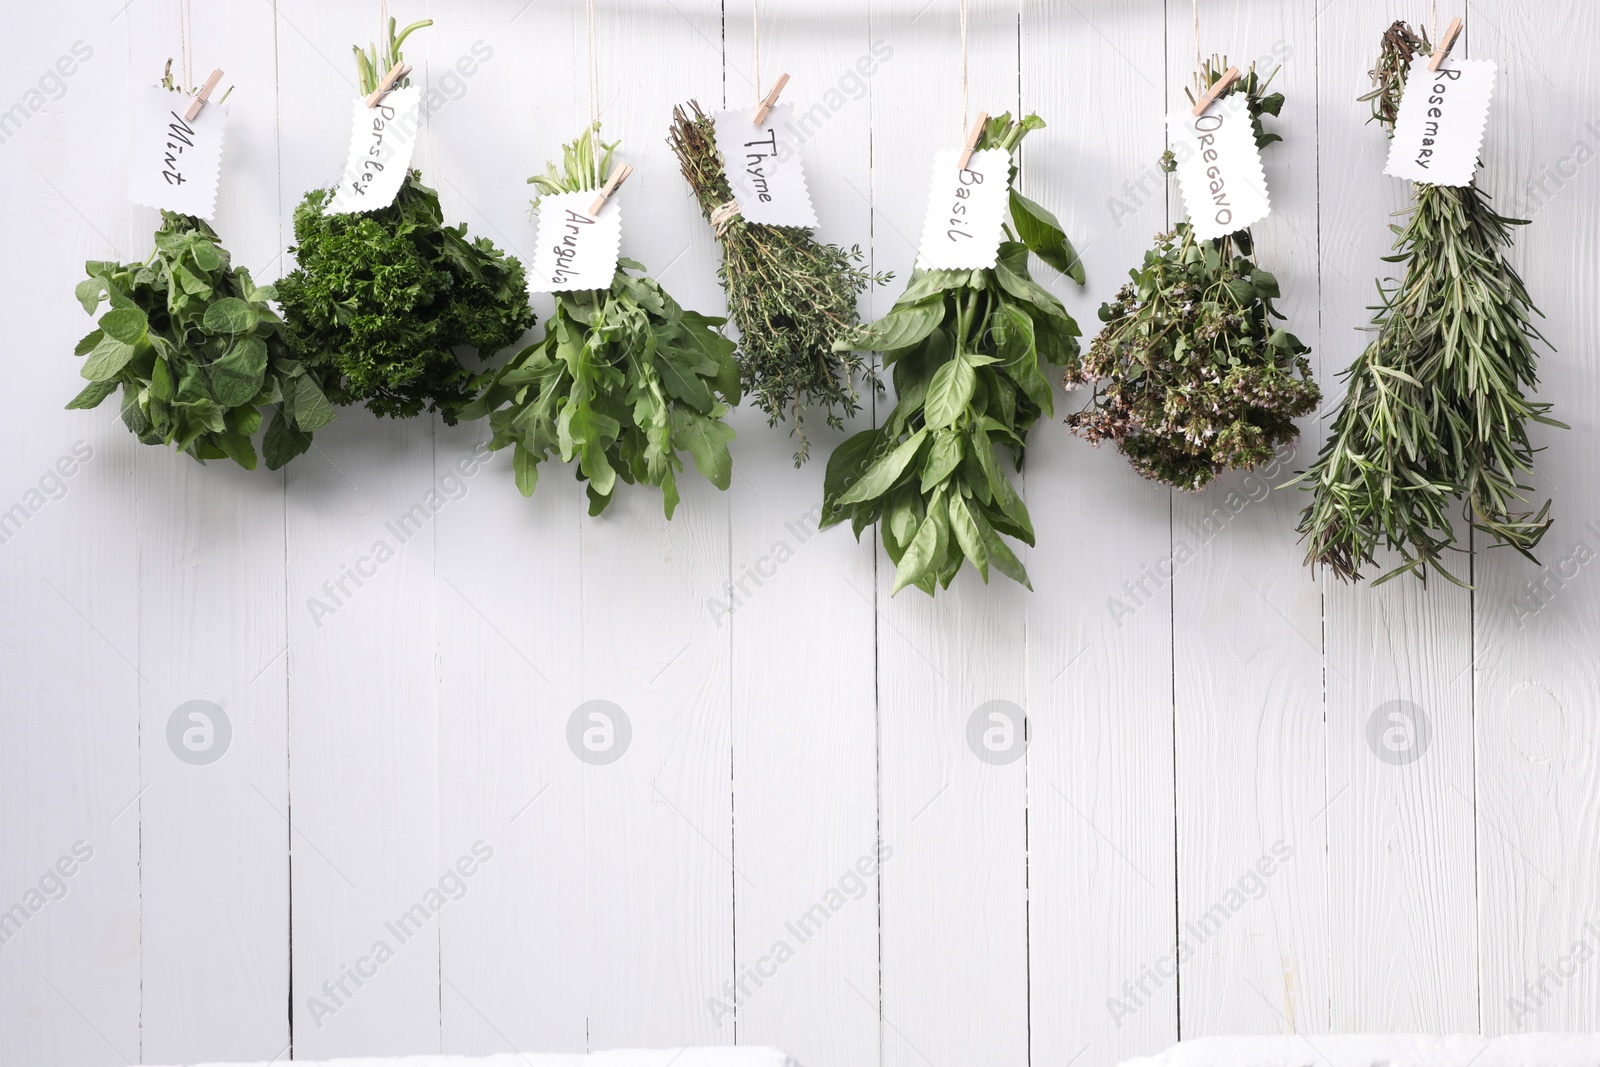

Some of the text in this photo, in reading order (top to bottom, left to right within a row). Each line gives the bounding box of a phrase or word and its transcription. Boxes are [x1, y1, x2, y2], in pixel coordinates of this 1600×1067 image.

[162, 111, 195, 185] Mint
[352, 104, 395, 198] Parsley
[744, 128, 777, 203] Thyme
[947, 168, 984, 243] Basil
[552, 209, 595, 284] Arugula
